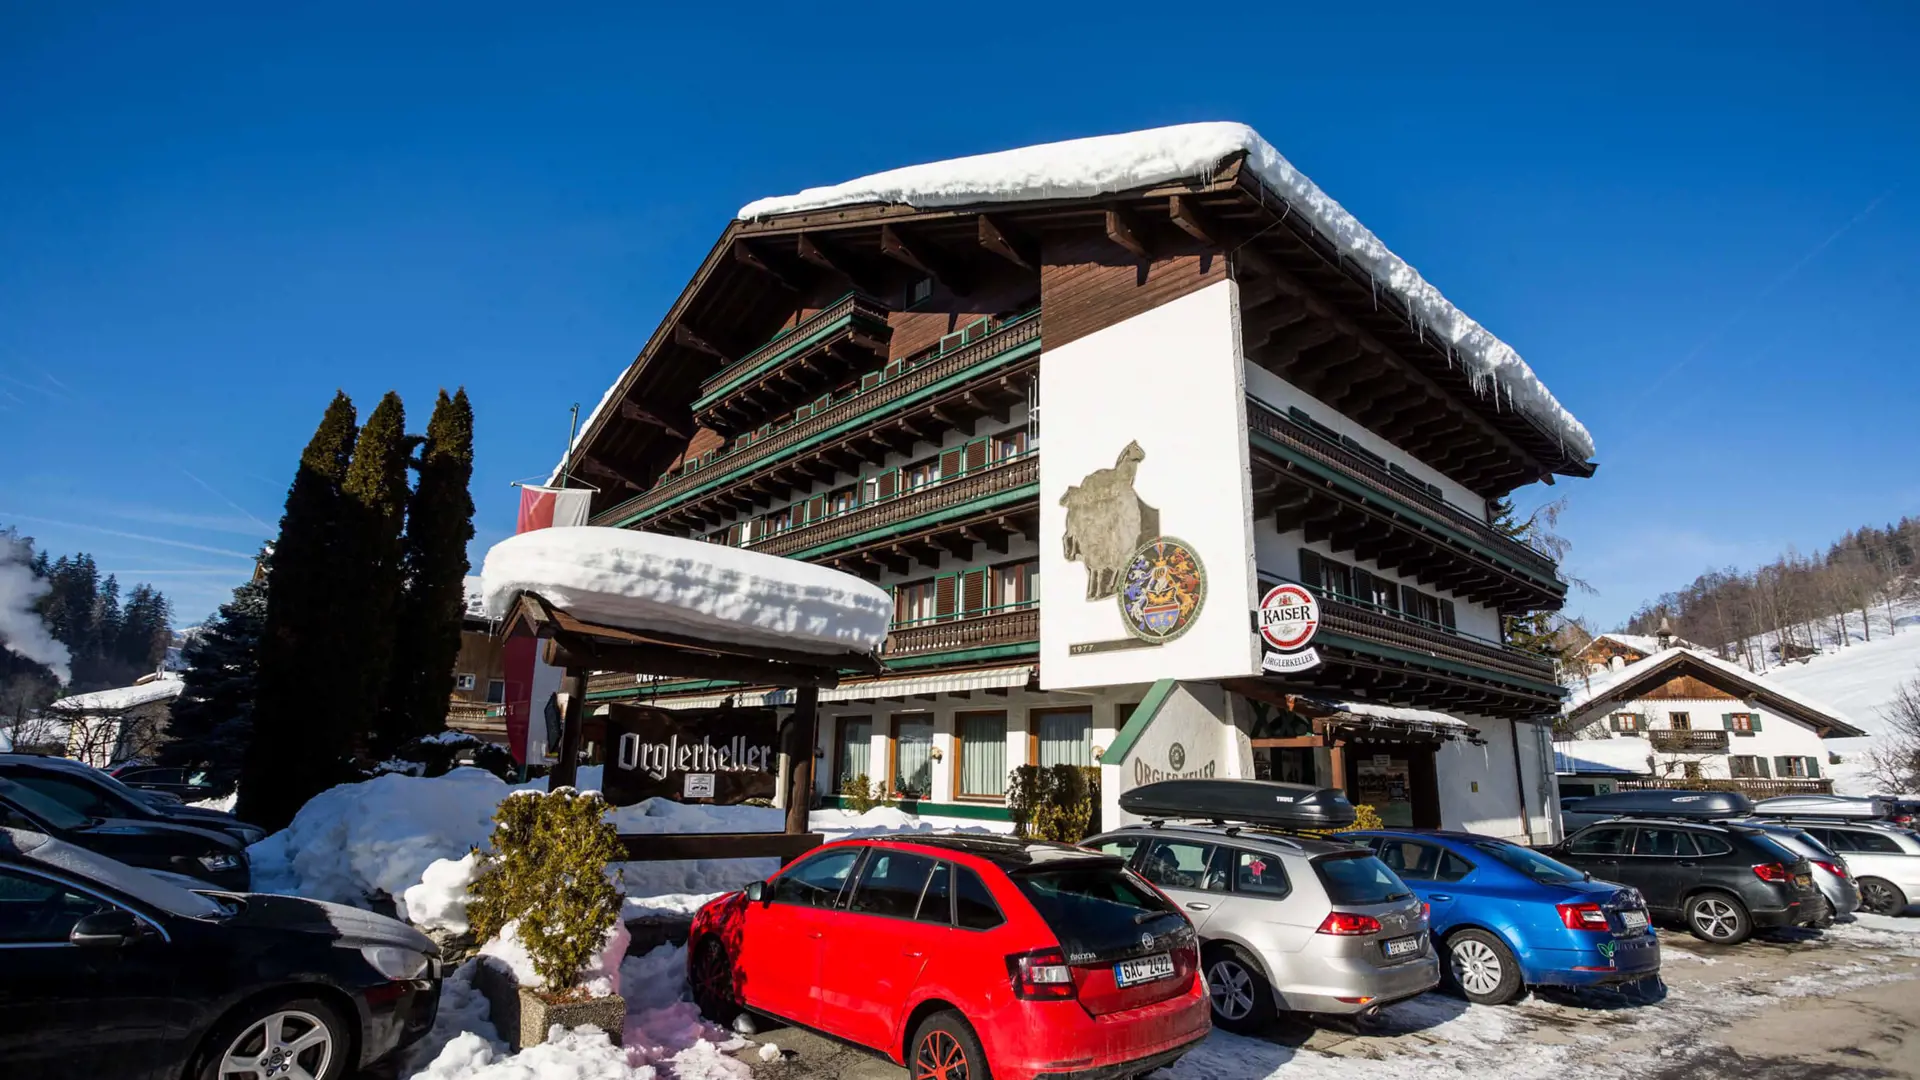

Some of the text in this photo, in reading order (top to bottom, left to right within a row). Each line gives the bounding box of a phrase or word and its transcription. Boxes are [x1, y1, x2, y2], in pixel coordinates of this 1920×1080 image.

[1263, 605, 1312, 625] KAISER
[1072, 644, 1094, 653] 1977
[1265, 653, 1315, 668] ORGLERKELLER
[618, 732, 771, 781] Orglerkeller
[1124, 954, 1171, 980] 6AC 2422
